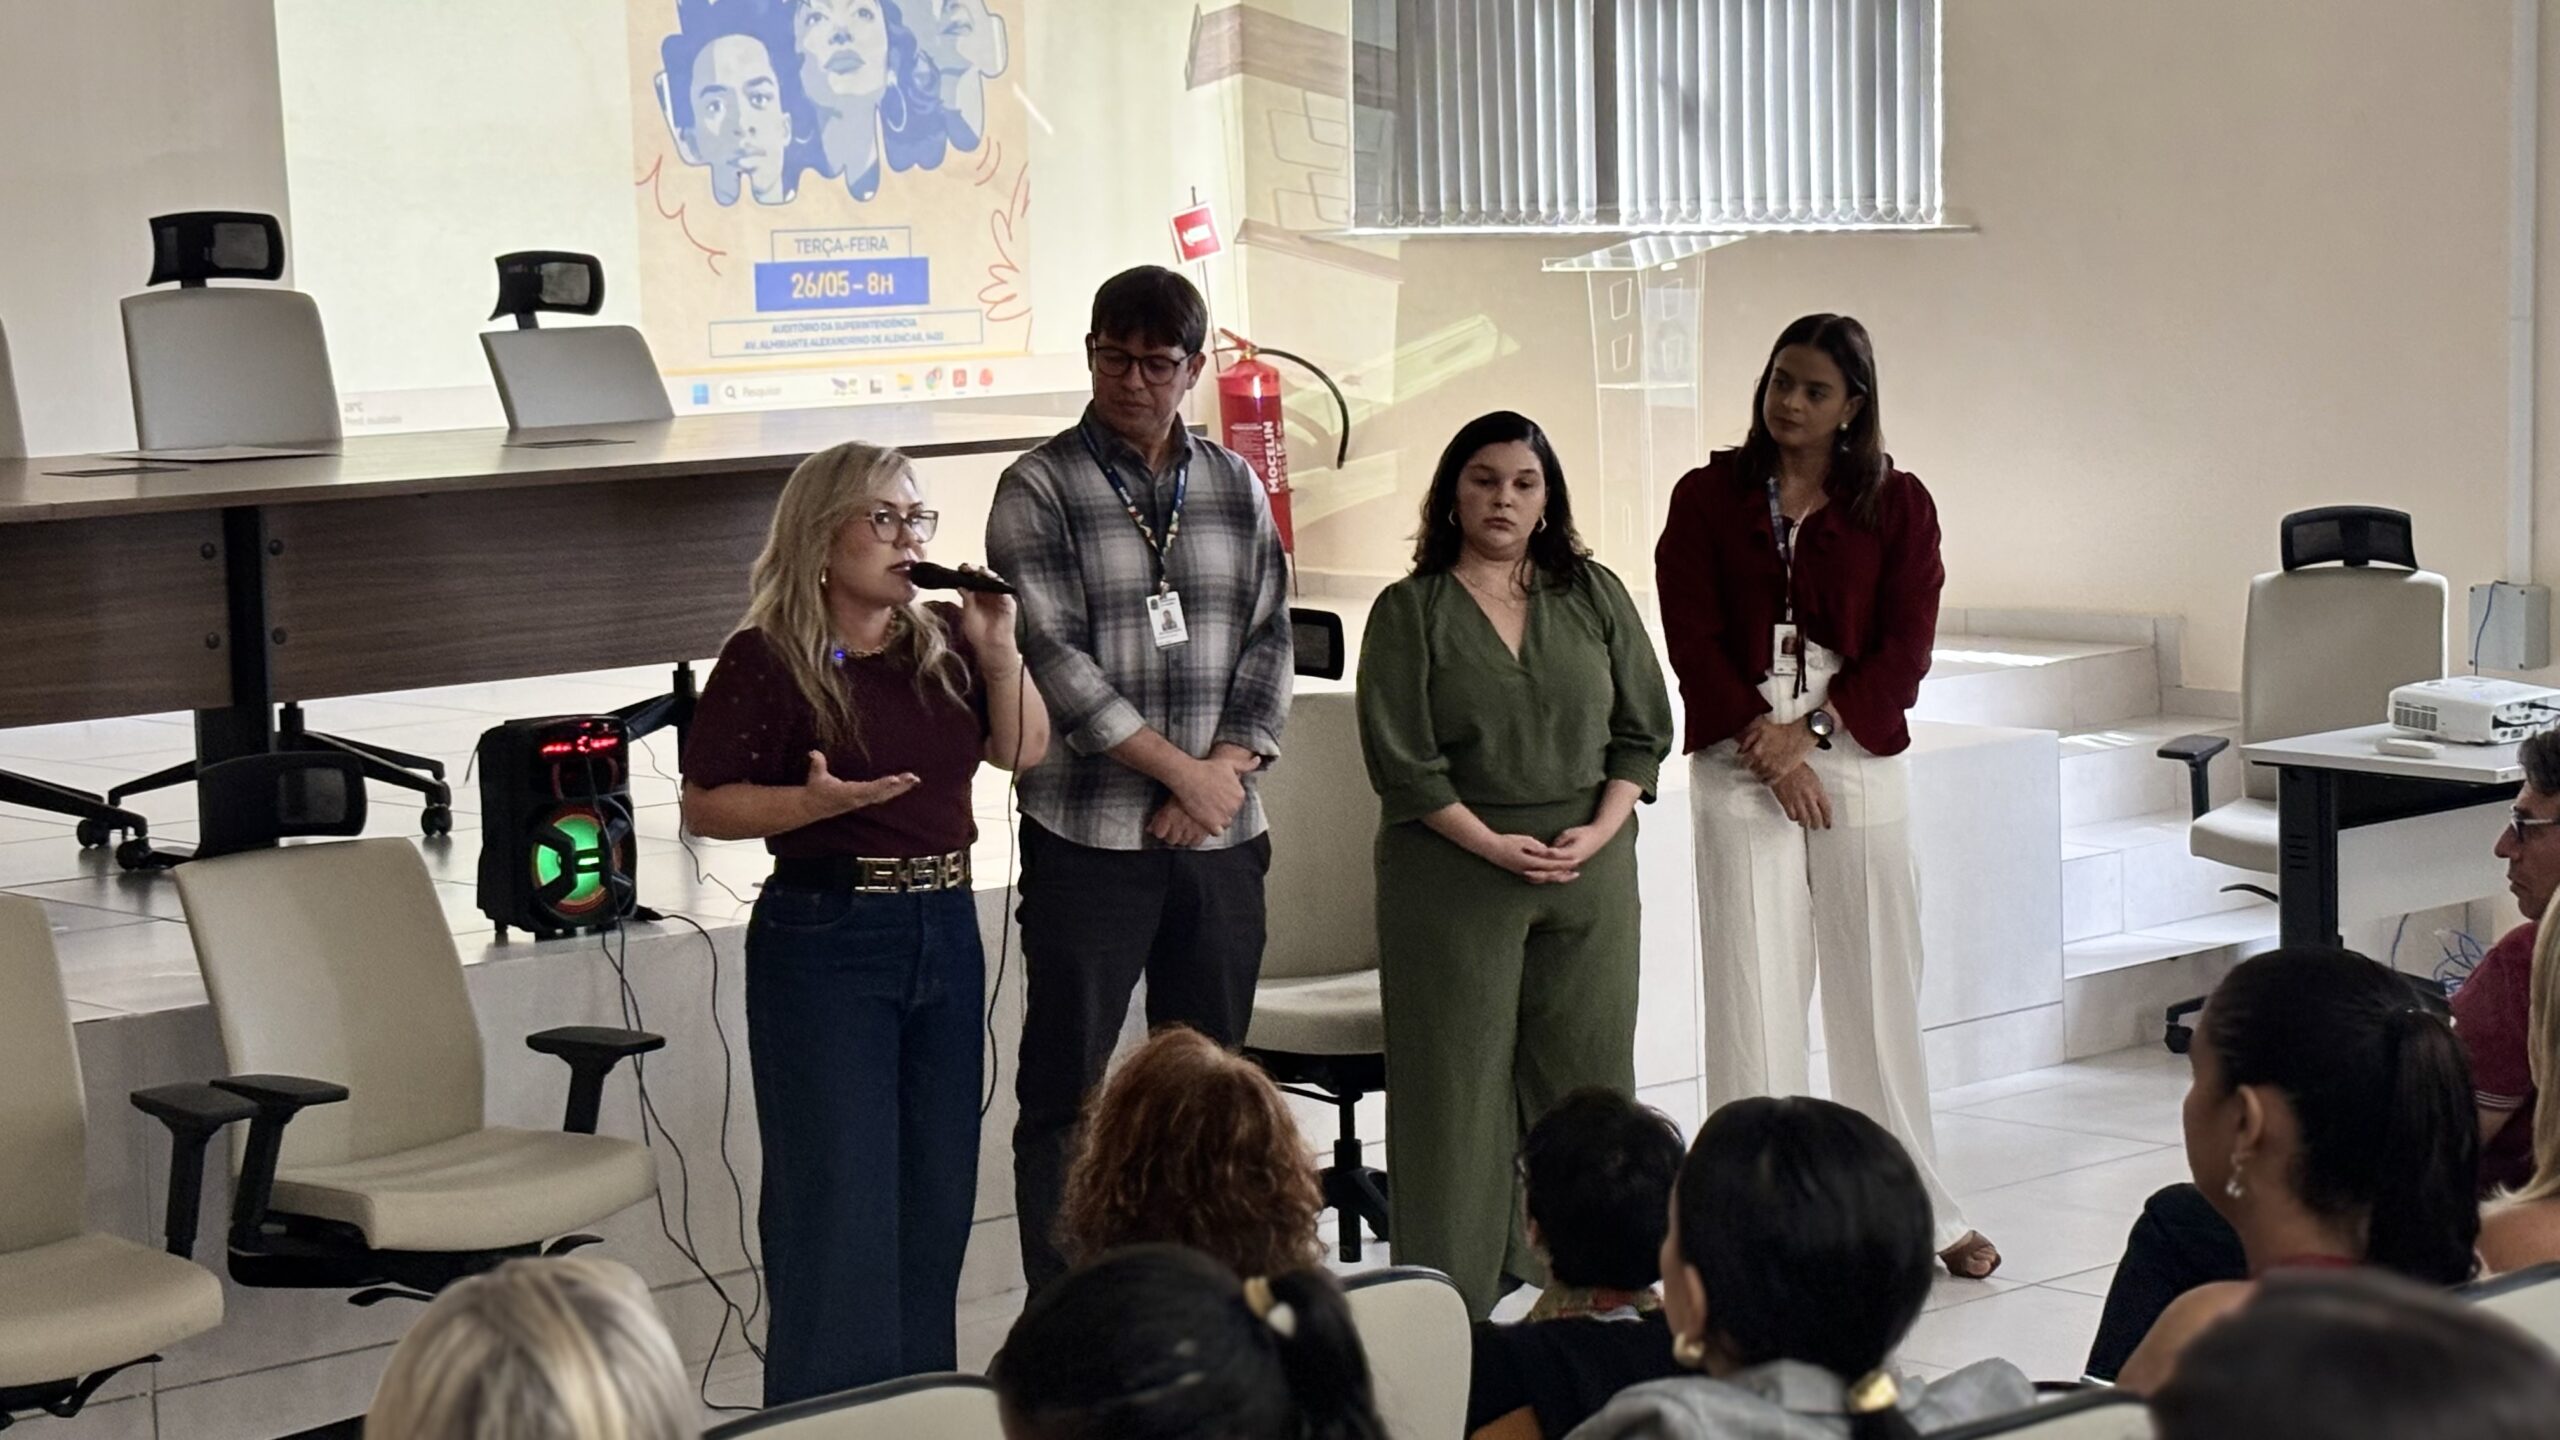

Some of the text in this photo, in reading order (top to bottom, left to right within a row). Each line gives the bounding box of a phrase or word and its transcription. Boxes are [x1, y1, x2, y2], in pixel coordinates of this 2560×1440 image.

[793, 235, 889, 258] TERÇA-FEIRA
[791, 269, 850, 299] 26/05
[867, 271, 894, 296] 8H
[820, 321, 833, 332] DA
[1262, 421, 1280, 494] MOCELIN
